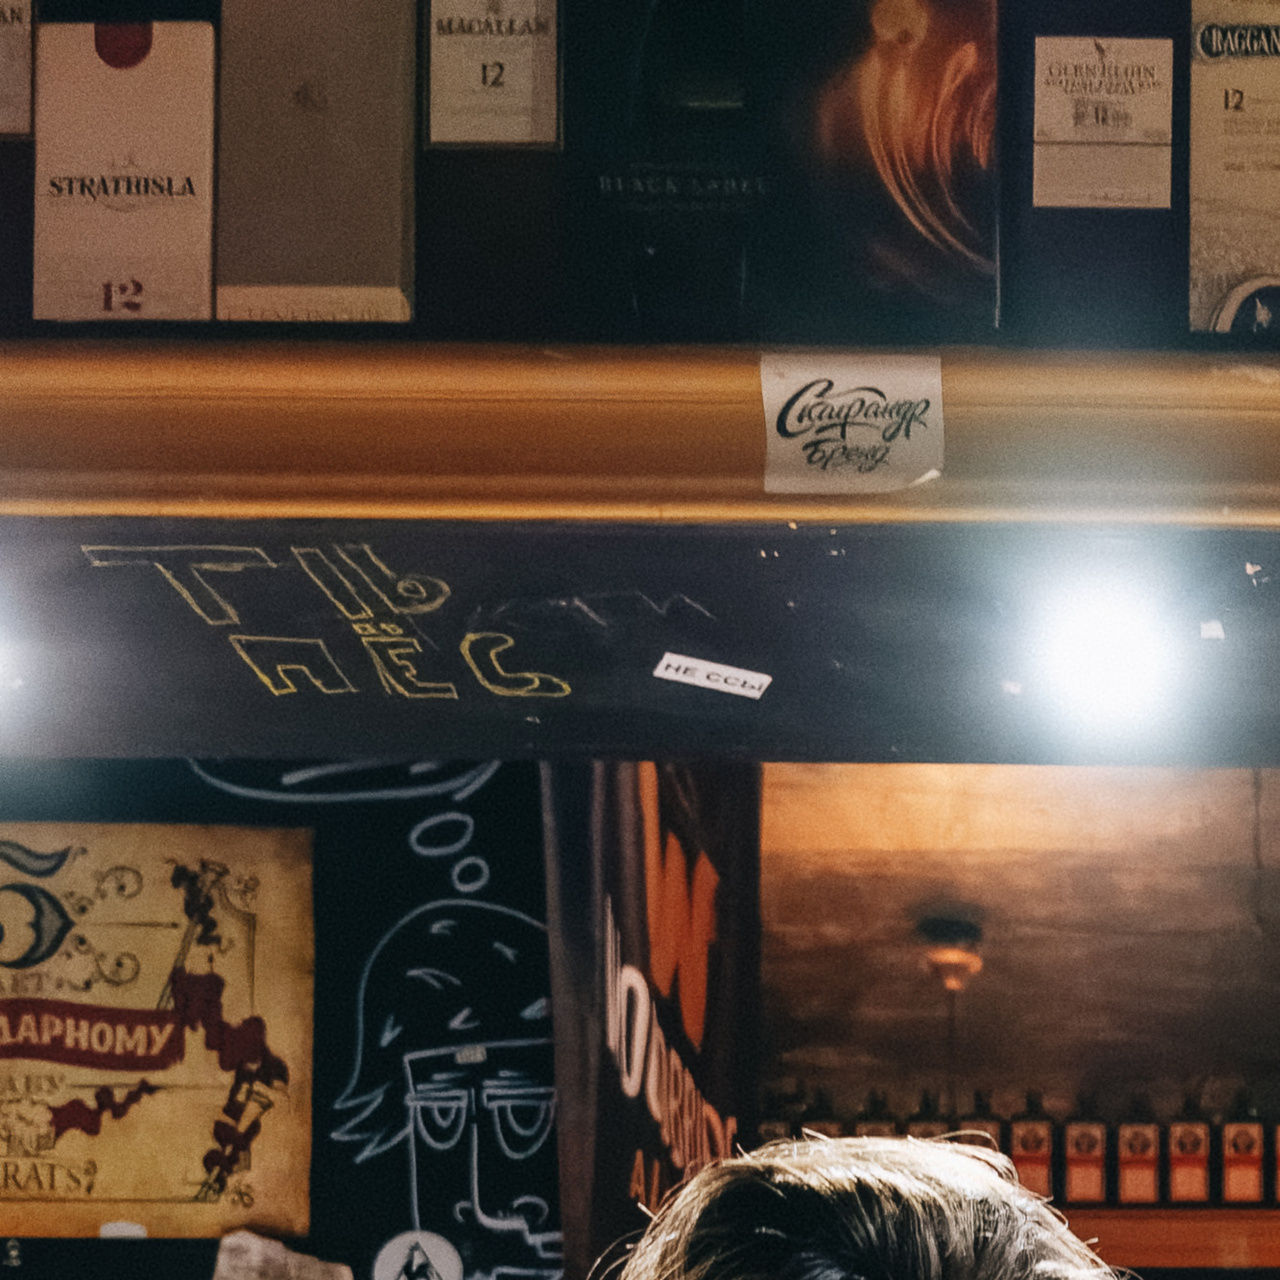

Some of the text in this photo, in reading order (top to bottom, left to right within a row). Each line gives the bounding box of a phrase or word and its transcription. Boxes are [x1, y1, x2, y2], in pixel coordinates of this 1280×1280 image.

[435, 17, 551, 36] MACALLAN
[480, 61, 506, 88] 12
[1221, 89, 1245, 111] 12
[48, 175, 197, 202] STRATHISLA
[101, 279, 144, 312] 12
